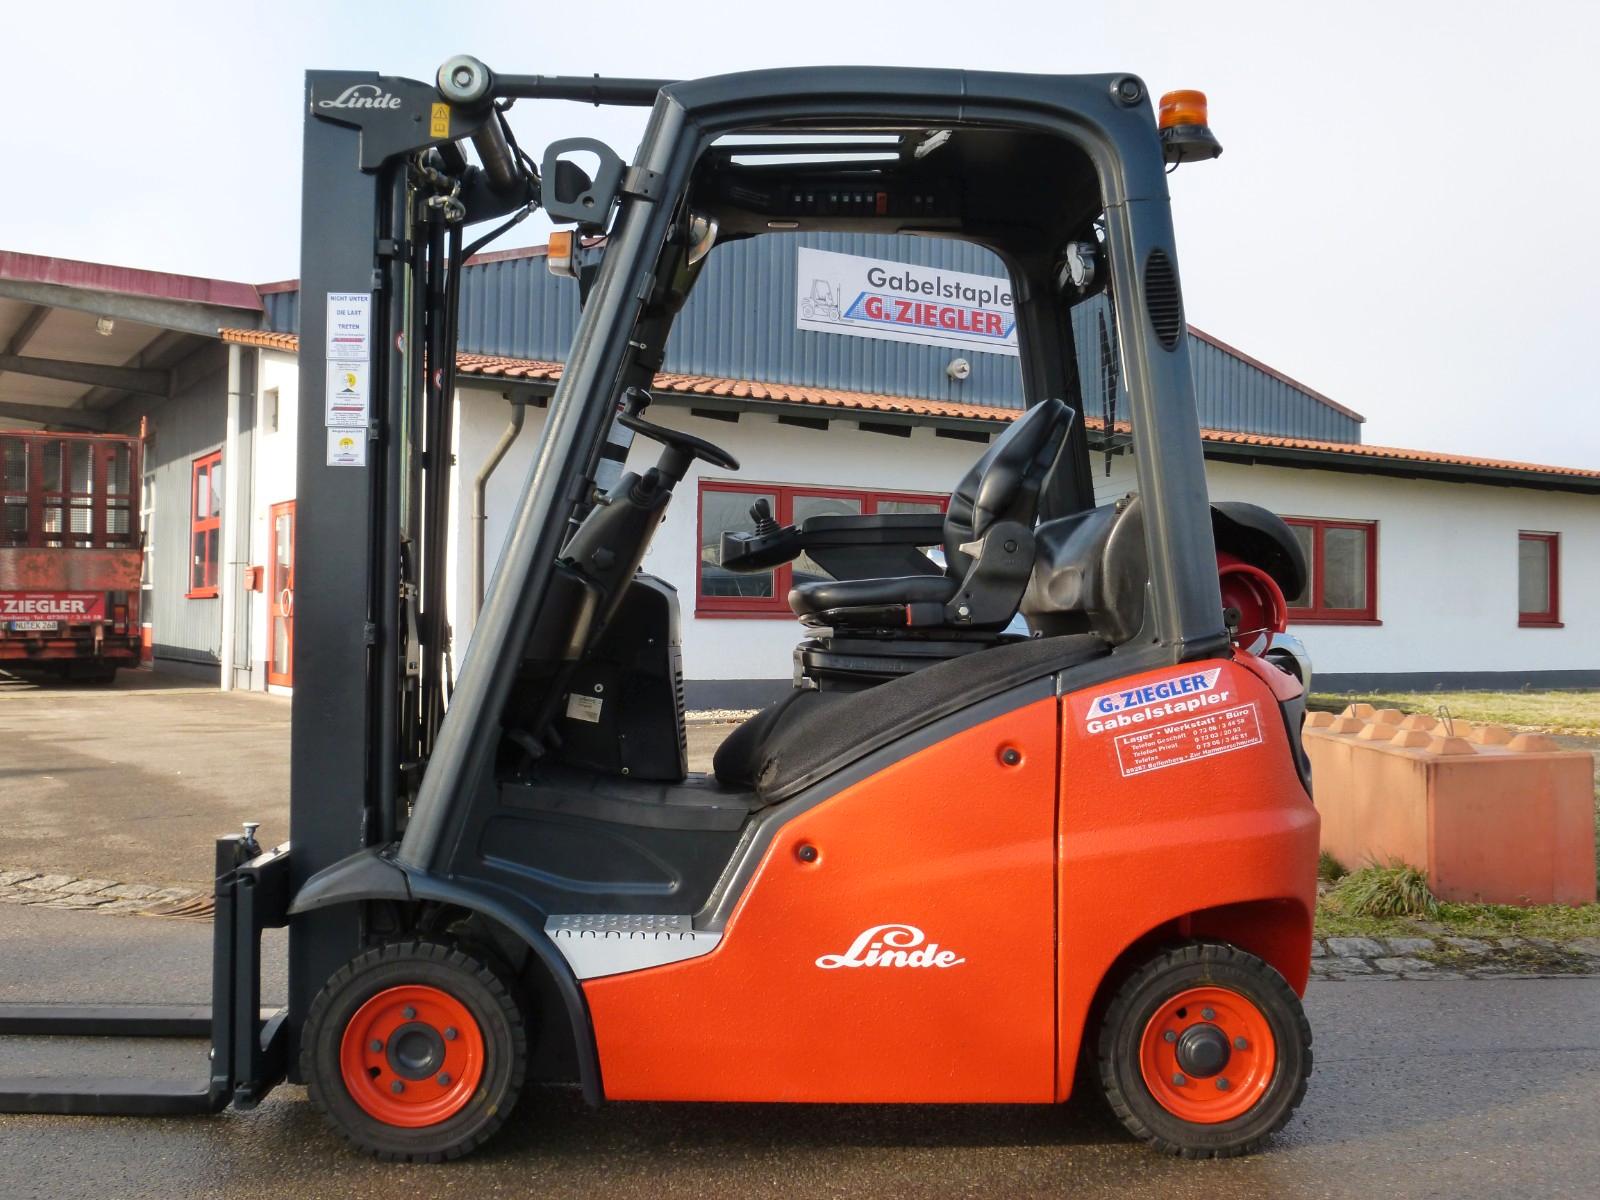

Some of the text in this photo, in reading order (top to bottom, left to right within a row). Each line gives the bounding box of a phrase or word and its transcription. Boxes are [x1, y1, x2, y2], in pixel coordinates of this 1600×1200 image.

[318, 84, 402, 109] Linde
[864, 296, 1005, 336] G. ZIEGLER
[4, 599, 86, 613] ZIEGLER
[1098, 674, 1208, 713] G. ZIEGLER
[1086, 691, 1229, 734] Gabelstapler
[1123, 710, 1249, 744] Lager Werkstatt Büro
[1132, 741, 1156, 750] Telefon
[1157, 733, 1186, 744] Geschäft
[1134, 748, 1158, 757] Telefon
[1158, 743, 1178, 751] Privat
[814, 923, 966, 969] Linde
